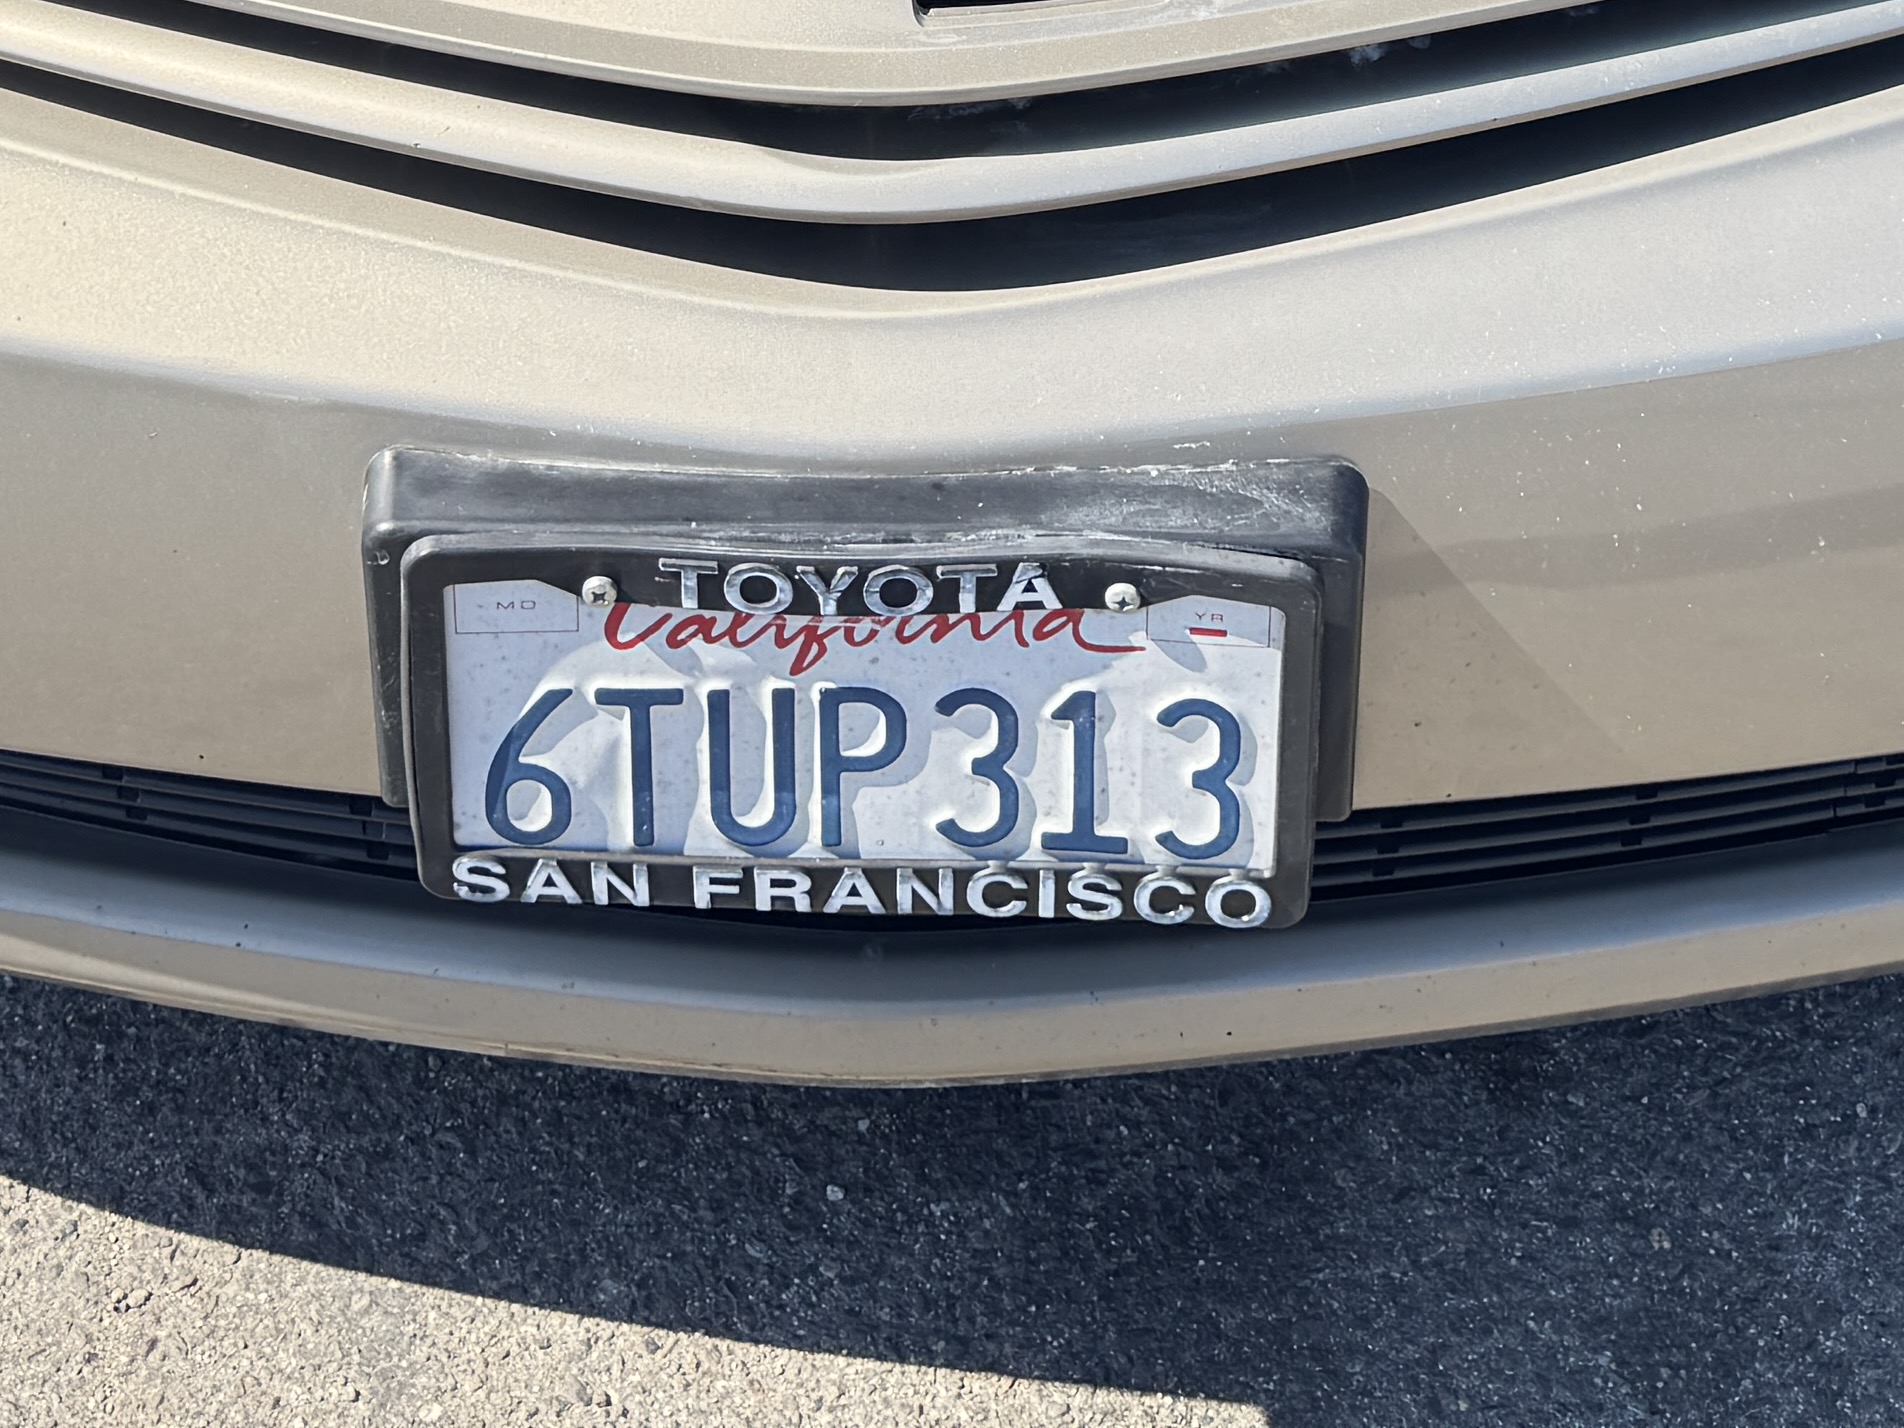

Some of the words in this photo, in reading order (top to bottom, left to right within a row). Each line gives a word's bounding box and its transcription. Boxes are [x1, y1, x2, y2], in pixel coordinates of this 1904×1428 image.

[496, 600, 537, 610] MO
[658, 557, 1066, 617] TOYOTA
[1194, 608, 1224, 622] YR
[484, 686, 1242, 861] 6TUP313
[450, 854, 651, 908] SAN
[695, 868, 1272, 929] FRANCISCO
